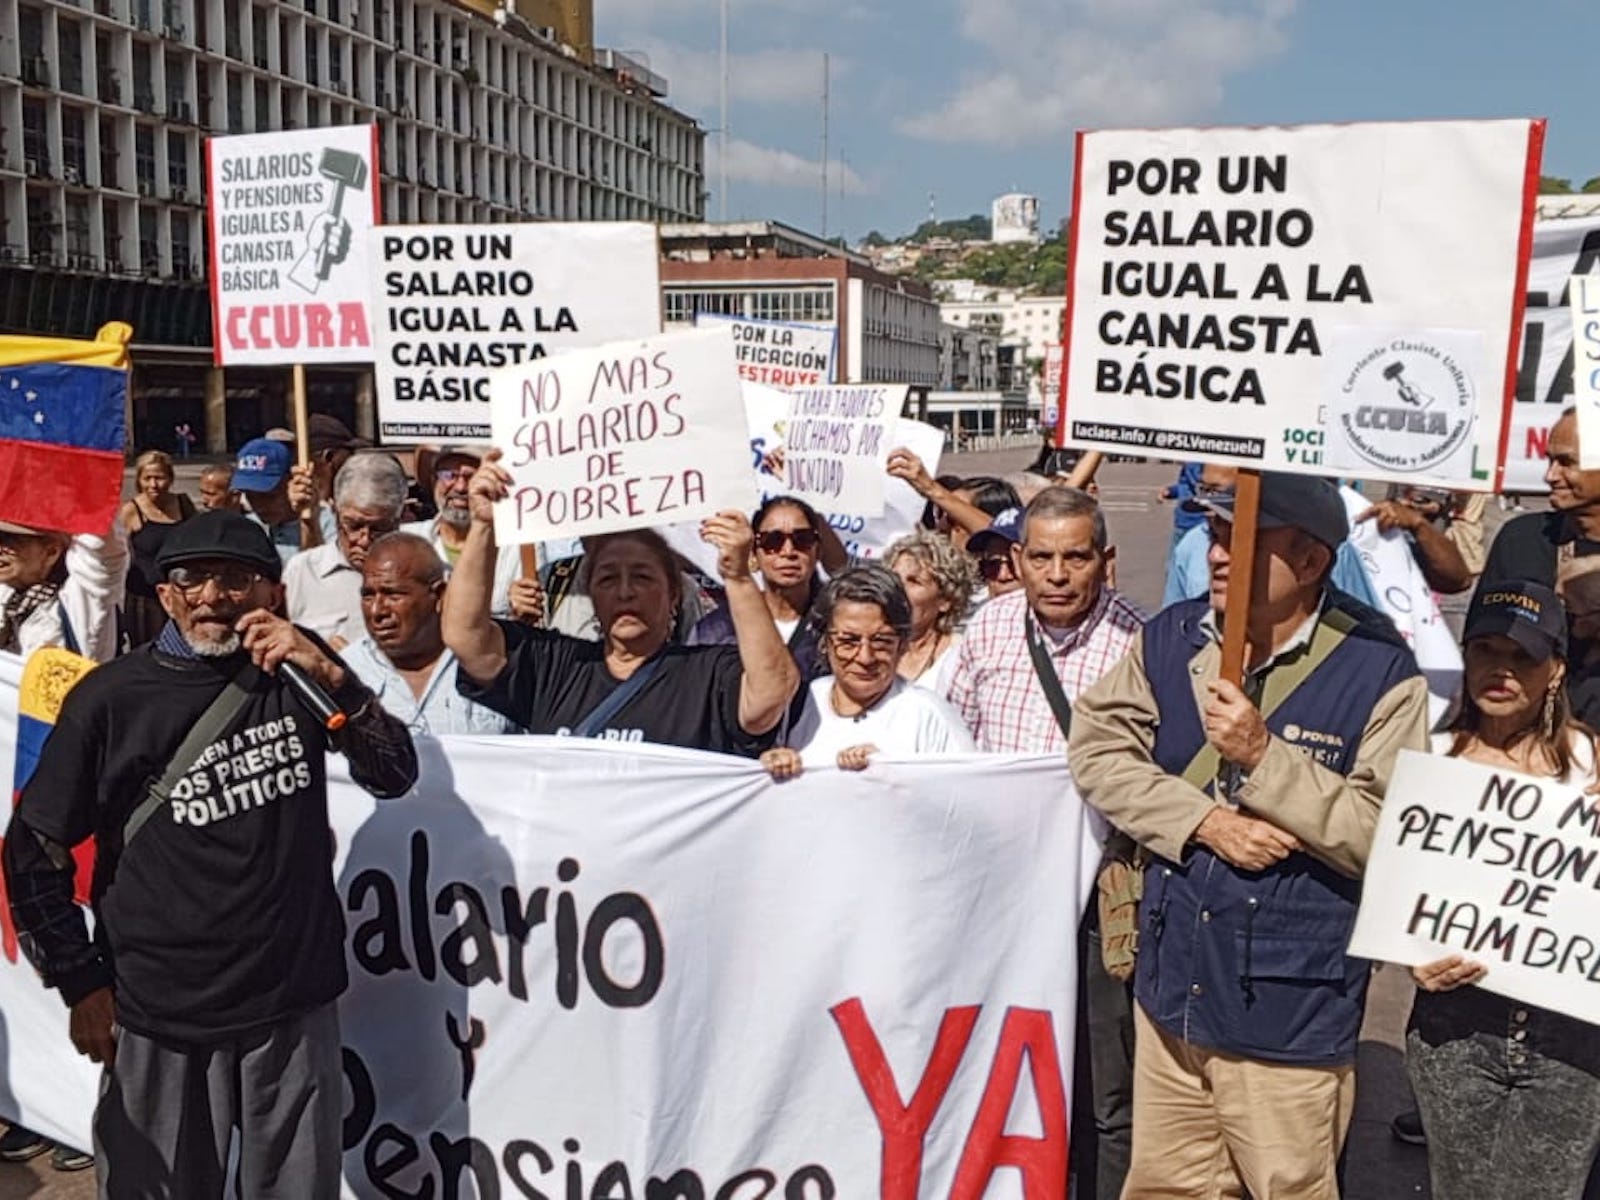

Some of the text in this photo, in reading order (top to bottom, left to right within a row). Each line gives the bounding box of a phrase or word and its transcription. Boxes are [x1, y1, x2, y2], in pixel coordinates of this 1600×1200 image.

[222, 153, 313, 182] SALARIOS
[1107, 155, 1287, 196] POR UN
[222, 183, 323, 210] Y PENSIONES
[222, 210, 304, 236] IGUALES A
[1103, 208, 1313, 247] SALARIO
[222, 240, 294, 264] CANASTA
[384, 235, 512, 261] POR UN
[222, 266, 280, 292] BÁSICA
[386, 270, 534, 297] SALARIO
[1102, 260, 1374, 303] IGUAL A LA
[226, 302, 370, 350] CCURA
[389, 306, 578, 332] IGUAL A LA
[1099, 311, 1322, 356] CANASTA
[772, 330, 793, 346] LA
[736, 344, 827, 370] IFICACIÓN
[394, 370, 490, 402] BÁSIC
[738, 365, 820, 386] ESTRUYE
[1096, 351, 1266, 405] BÁSICA
[522, 370, 561, 418] NO
[512, 393, 685, 467] SALARIOS
[1355, 405, 1448, 436] CCURA
[788, 419, 883, 456] LUCHAMOS POR
[1075, 423, 1146, 444] laclase.info
[1156, 432, 1261, 455] @PSLVenezuela
[587, 451, 625, 482] DE
[1285, 449, 1297, 463] Y
[514, 469, 705, 530] POBREZA
[1483, 593, 1541, 613] EDWIN
[232, 733, 244, 752] A
[171, 761, 311, 826] POLÍTICOS
[1478, 774, 1542, 821] NO
[1398, 805, 1600, 890] PENSION
[1500, 878, 1557, 917] DE
[347, 829, 666, 1010] alario
[827, 996, 1069, 1200] YA
